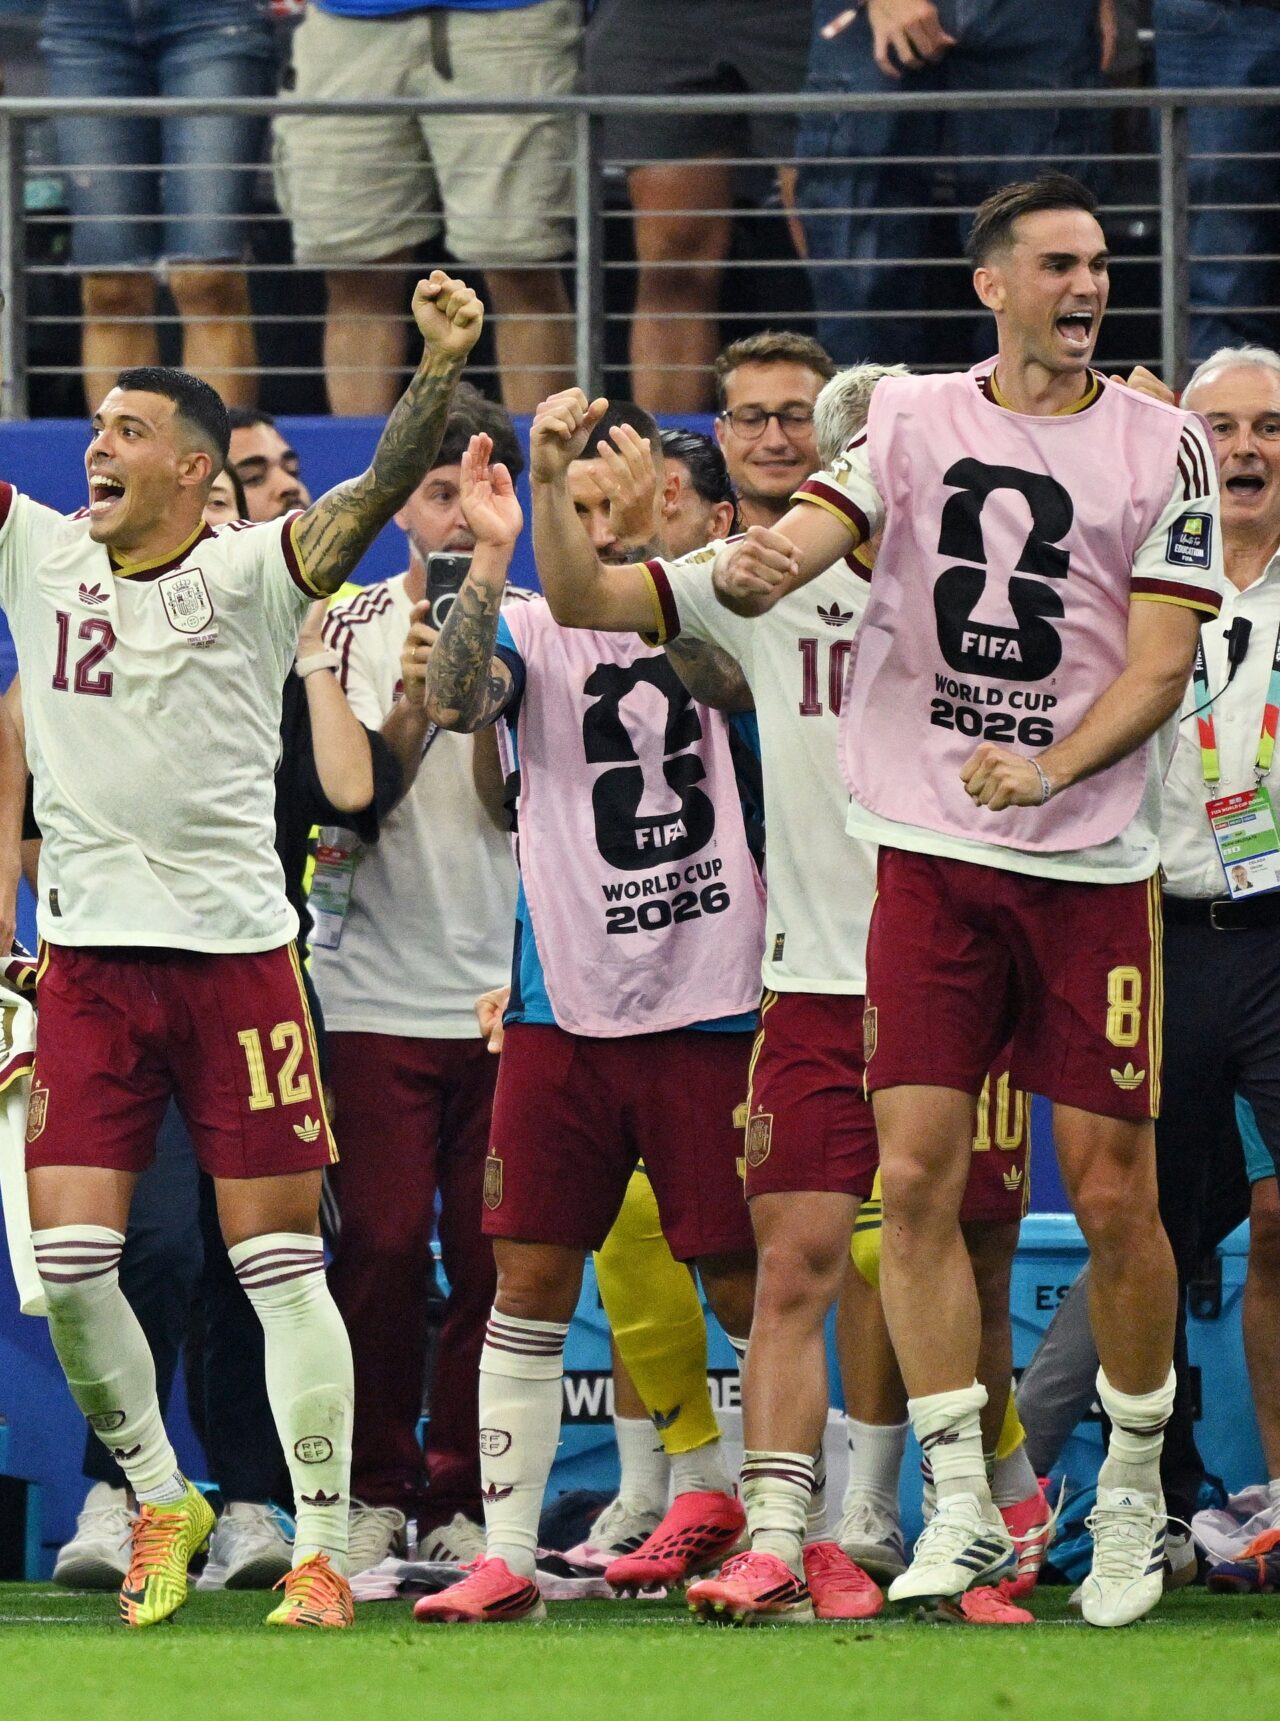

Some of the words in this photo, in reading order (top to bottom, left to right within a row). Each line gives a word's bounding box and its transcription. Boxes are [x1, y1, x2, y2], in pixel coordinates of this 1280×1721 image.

[52, 610, 118, 697] 12
[960, 631, 1023, 662] FIFA
[935, 673, 1003, 706] WORLD
[1008, 691, 1058, 712] CUP
[930, 698, 1054, 747] 2026
[635, 819, 688, 849] FIFA
[602, 872, 681, 901] WORLD
[684, 858, 722, 884] CUP
[605, 882, 730, 934] 2026
[1106, 965, 1142, 1047] 8
[237, 1020, 312, 1111] 12
[972, 1070, 1023, 1151] 10
